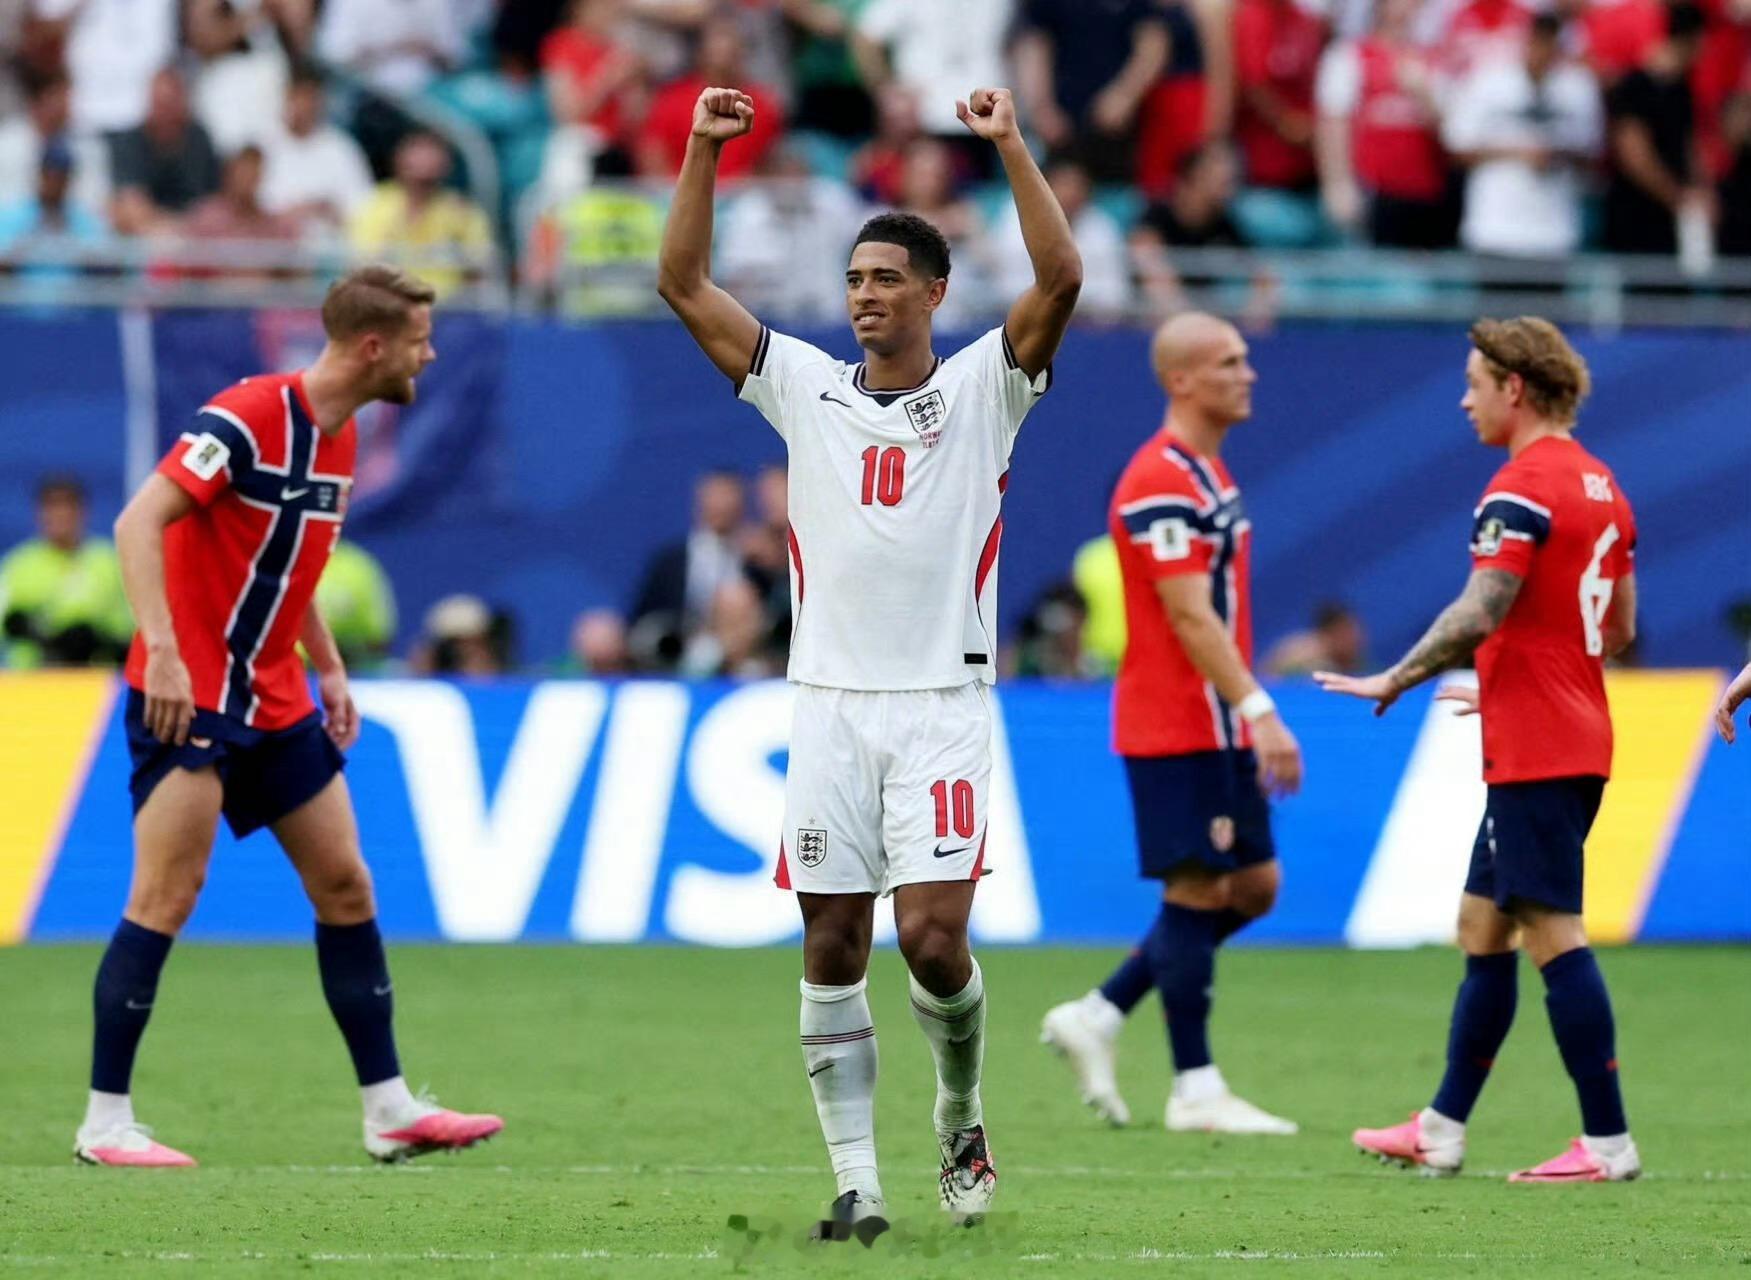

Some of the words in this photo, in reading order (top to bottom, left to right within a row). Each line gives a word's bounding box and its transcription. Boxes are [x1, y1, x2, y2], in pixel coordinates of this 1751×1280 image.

[861, 445, 906, 506] 10
[1578, 522, 1621, 657] 6
[349, 680, 1042, 948] VIS
[930, 778, 975, 839] 10
